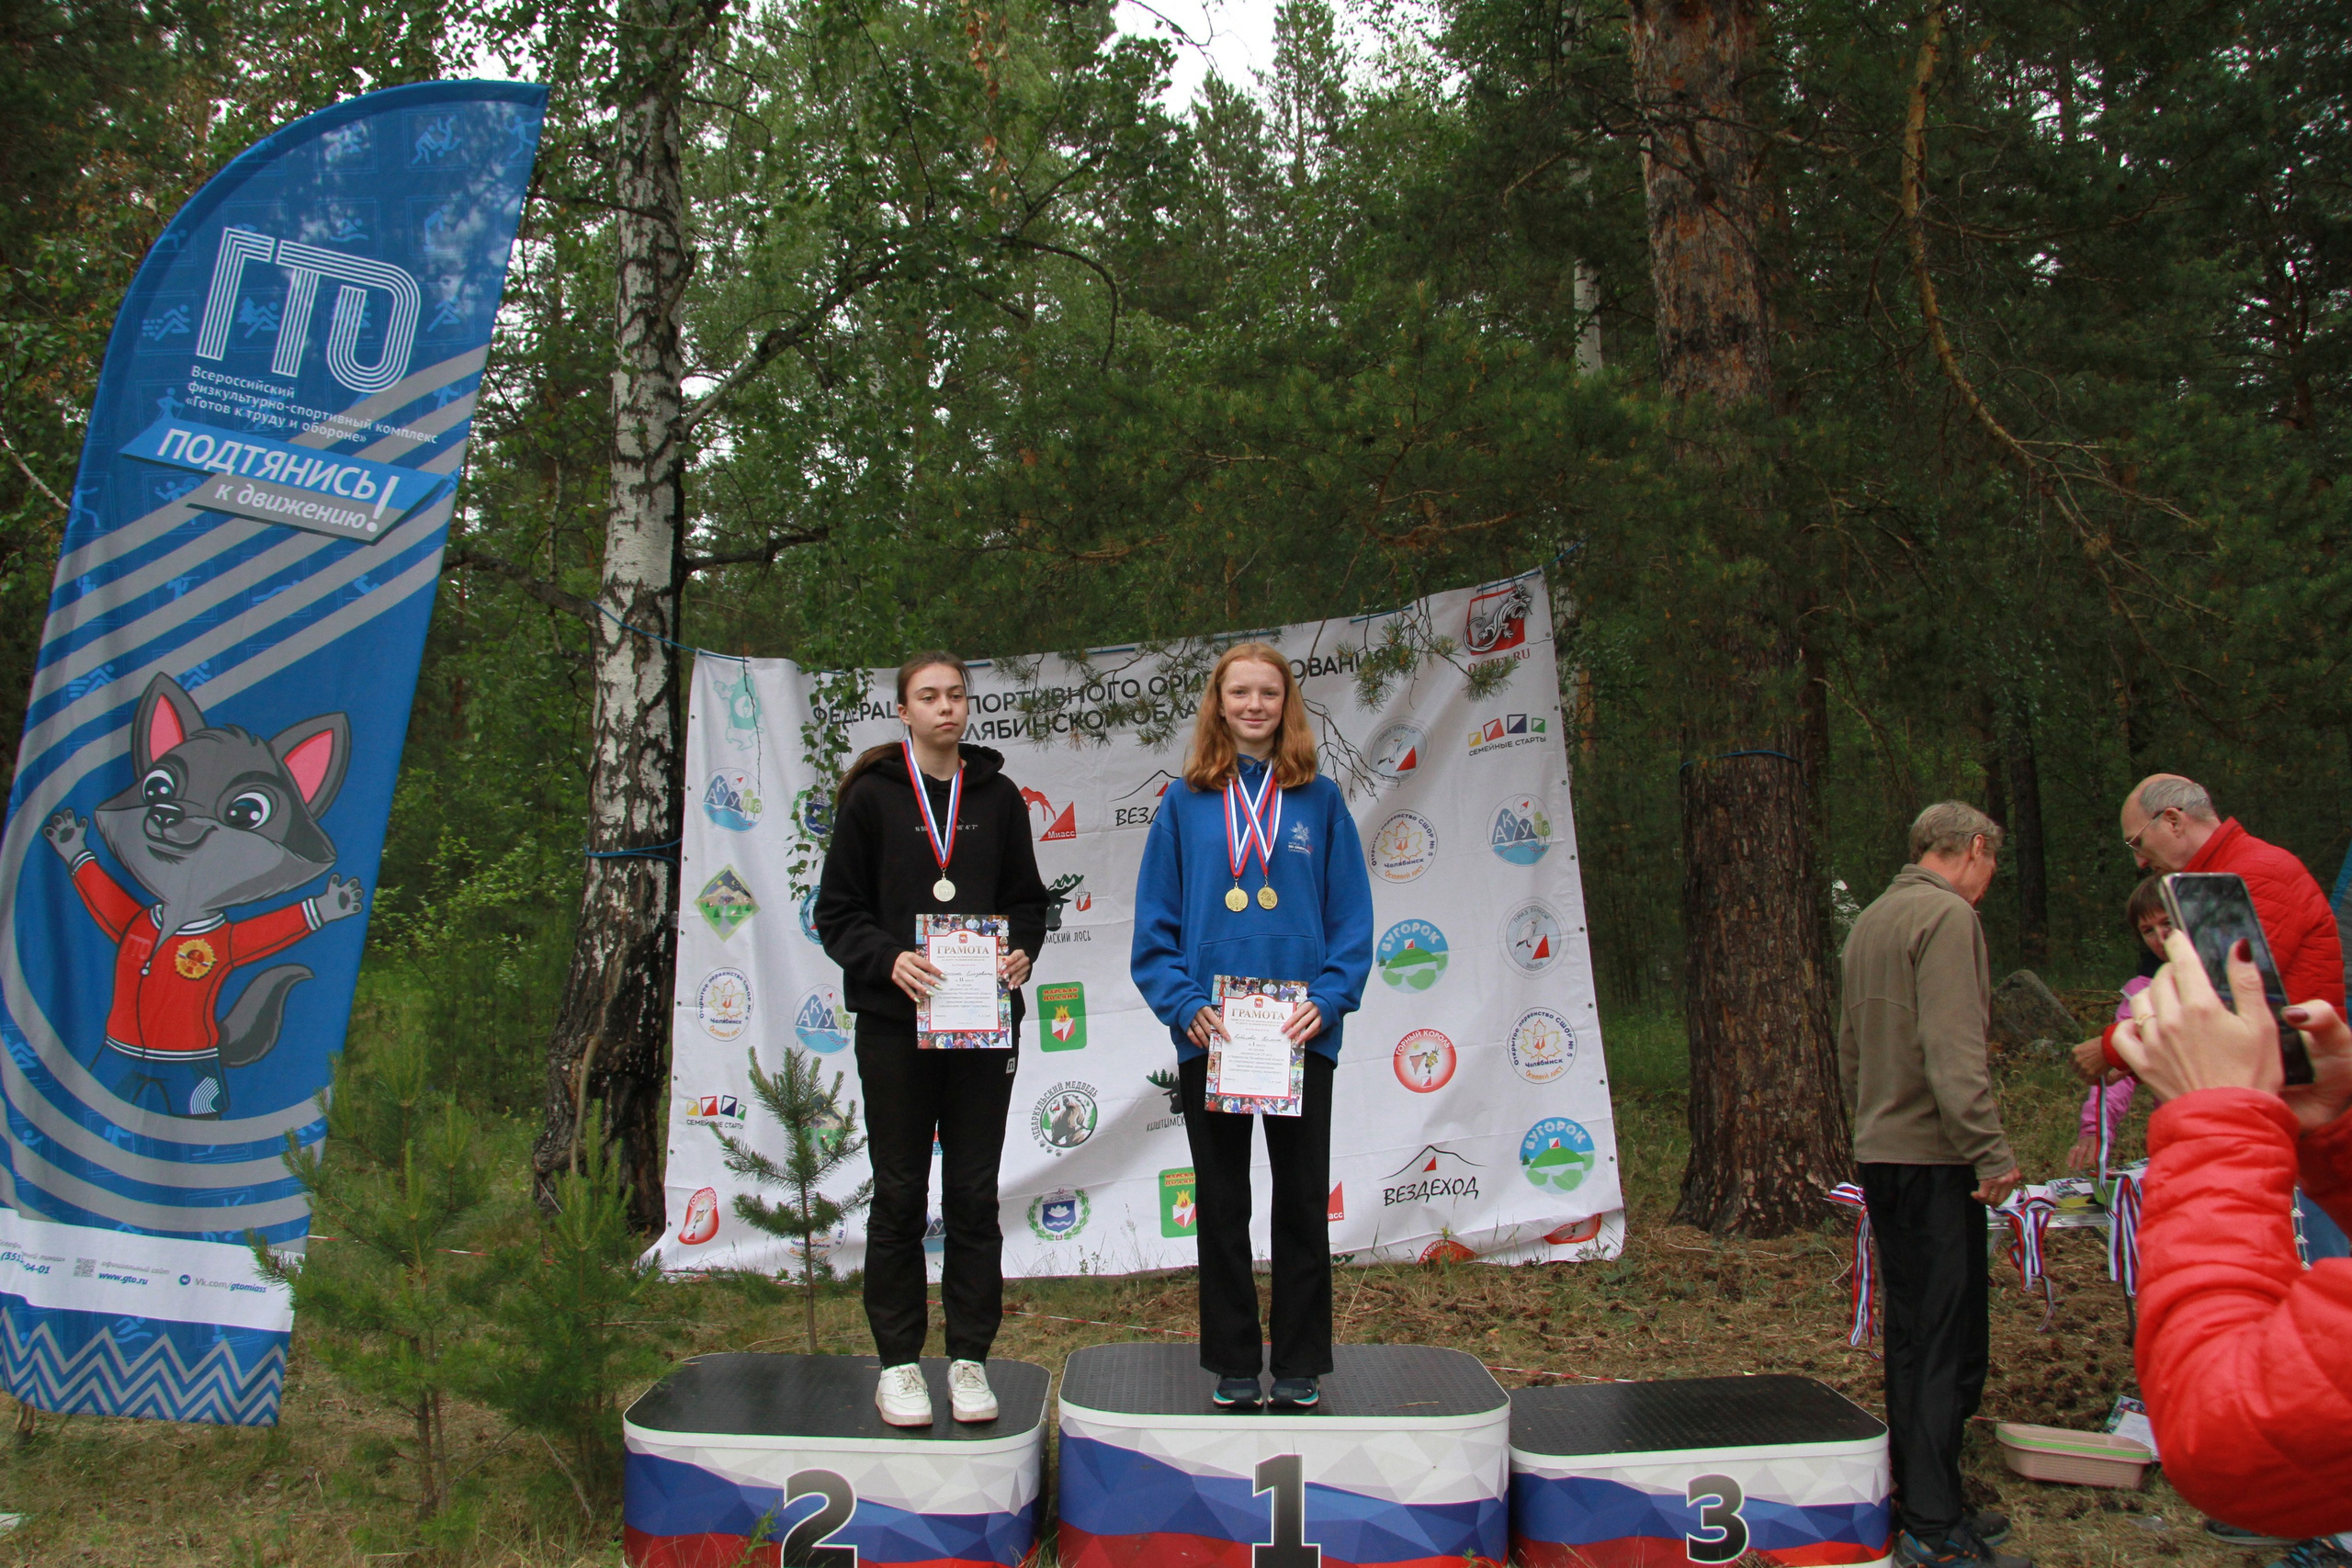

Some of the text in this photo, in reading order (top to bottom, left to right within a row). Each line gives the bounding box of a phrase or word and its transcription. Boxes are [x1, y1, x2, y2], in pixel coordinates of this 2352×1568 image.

[197, 227, 421, 393] ГТО
[191, 366, 295, 399] Всероссийский
[186, 396, 367, 443] «Готов к труду и обороне»
[187, 381, 438, 445] физкультурно-спортивный комплекс
[215, 484, 233, 502] к
[813, 701, 900, 724] ФЕДЕРАЦ
[967, 678, 1141, 715] ПОРТИВНОГО
[1469, 736, 1547, 756] СЕМЕЙНЫЕ СТАРТЫ
[1047, 830, 1075, 839] Миасс
[1385, 858, 1424, 868] Челябинск
[1043, 931, 1091, 944] МСКИЙ ЛОСЬ
[1382, 922, 1441, 952] БУГОРОК
[937, 945, 989, 954] ГРАМОТА
[1231, 1008, 1285, 1020] ГРАМОТА
[1396, 1030, 1451, 1055] ГОРНЫЙ КОРОЛЬ
[1525, 1058, 1563, 1067] Челябинск
[1031, 1080, 1098, 1141] ЧЕБАРКУЛЬСКИЙ МЕДВЕДЬ
[1147, 1115, 1186, 1132] КЫШТЫМСК
[1525, 1121, 1587, 1150] БУГОРОК
[1165, 1179, 1195, 1187] ПОЛЯН
[1383, 1176, 1479, 1206] ВЕЗДЕХОД
[1328, 1212, 1344, 1220] асс
[791, 1239, 831, 1248] Челинск
[98, 1272, 148, 1285] www.gto.ru
[781, 1469, 858, 1568] 2
[1252, 1453, 1321, 1568] 1
[1686, 1473, 1749, 1564] 3
